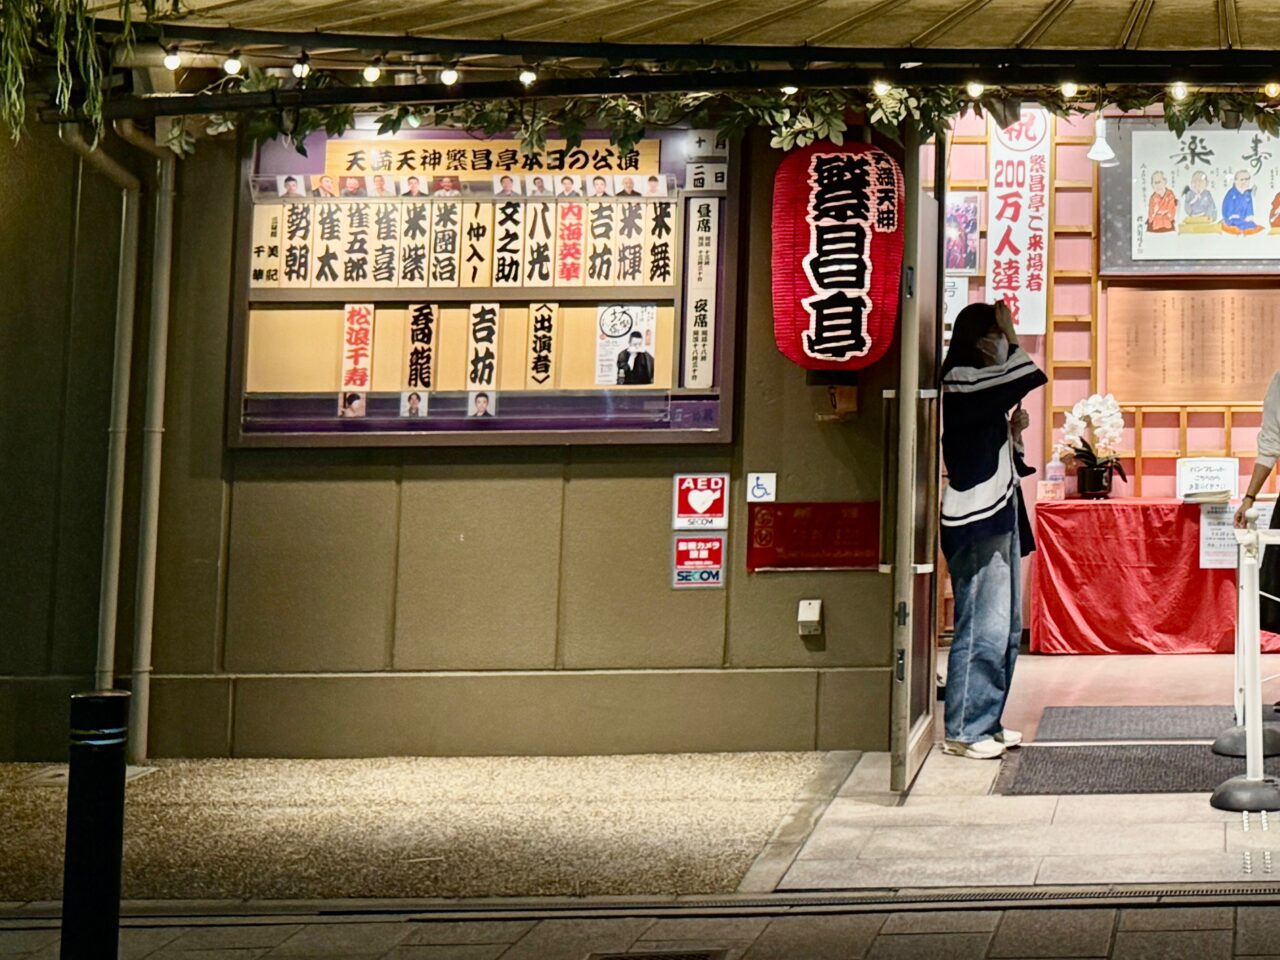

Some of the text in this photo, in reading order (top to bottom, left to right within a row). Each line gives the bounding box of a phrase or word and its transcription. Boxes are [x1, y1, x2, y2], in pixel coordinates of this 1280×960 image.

[346, 148, 642, 172] 天満天神繁昌亭本日の公演
[715, 172, 725, 183] 日
[285, 203, 310, 281] 勢朝
[316, 203, 341, 281] 雀太
[344, 203, 369, 281] 雀五郎
[373, 203, 398, 281] 雀喜
[402, 203, 427, 281] 米紫
[432, 203, 457, 281] 米團治
[496, 201, 521, 282] 文之助
[527, 202, 551, 281] 八光
[558, 203, 583, 280] 内海英華
[589, 202, 614, 280] 吉坊
[617, 202, 642, 280] 米輝
[650, 202, 671, 282] 米舞
[697, 203, 711, 233] 昼席
[808, 154, 870, 358] 繁昌亭
[1026, 155, 1047, 292] 繁昌亭ご来場者
[344, 306, 370, 387] 松浪千寿
[470, 306, 496, 385] 吉坊
[694, 298, 708, 328] 夜席
[681, 477, 723, 490] AED
[687, 518, 714, 526] SECOM
[676, 570, 720, 582] SECOM
